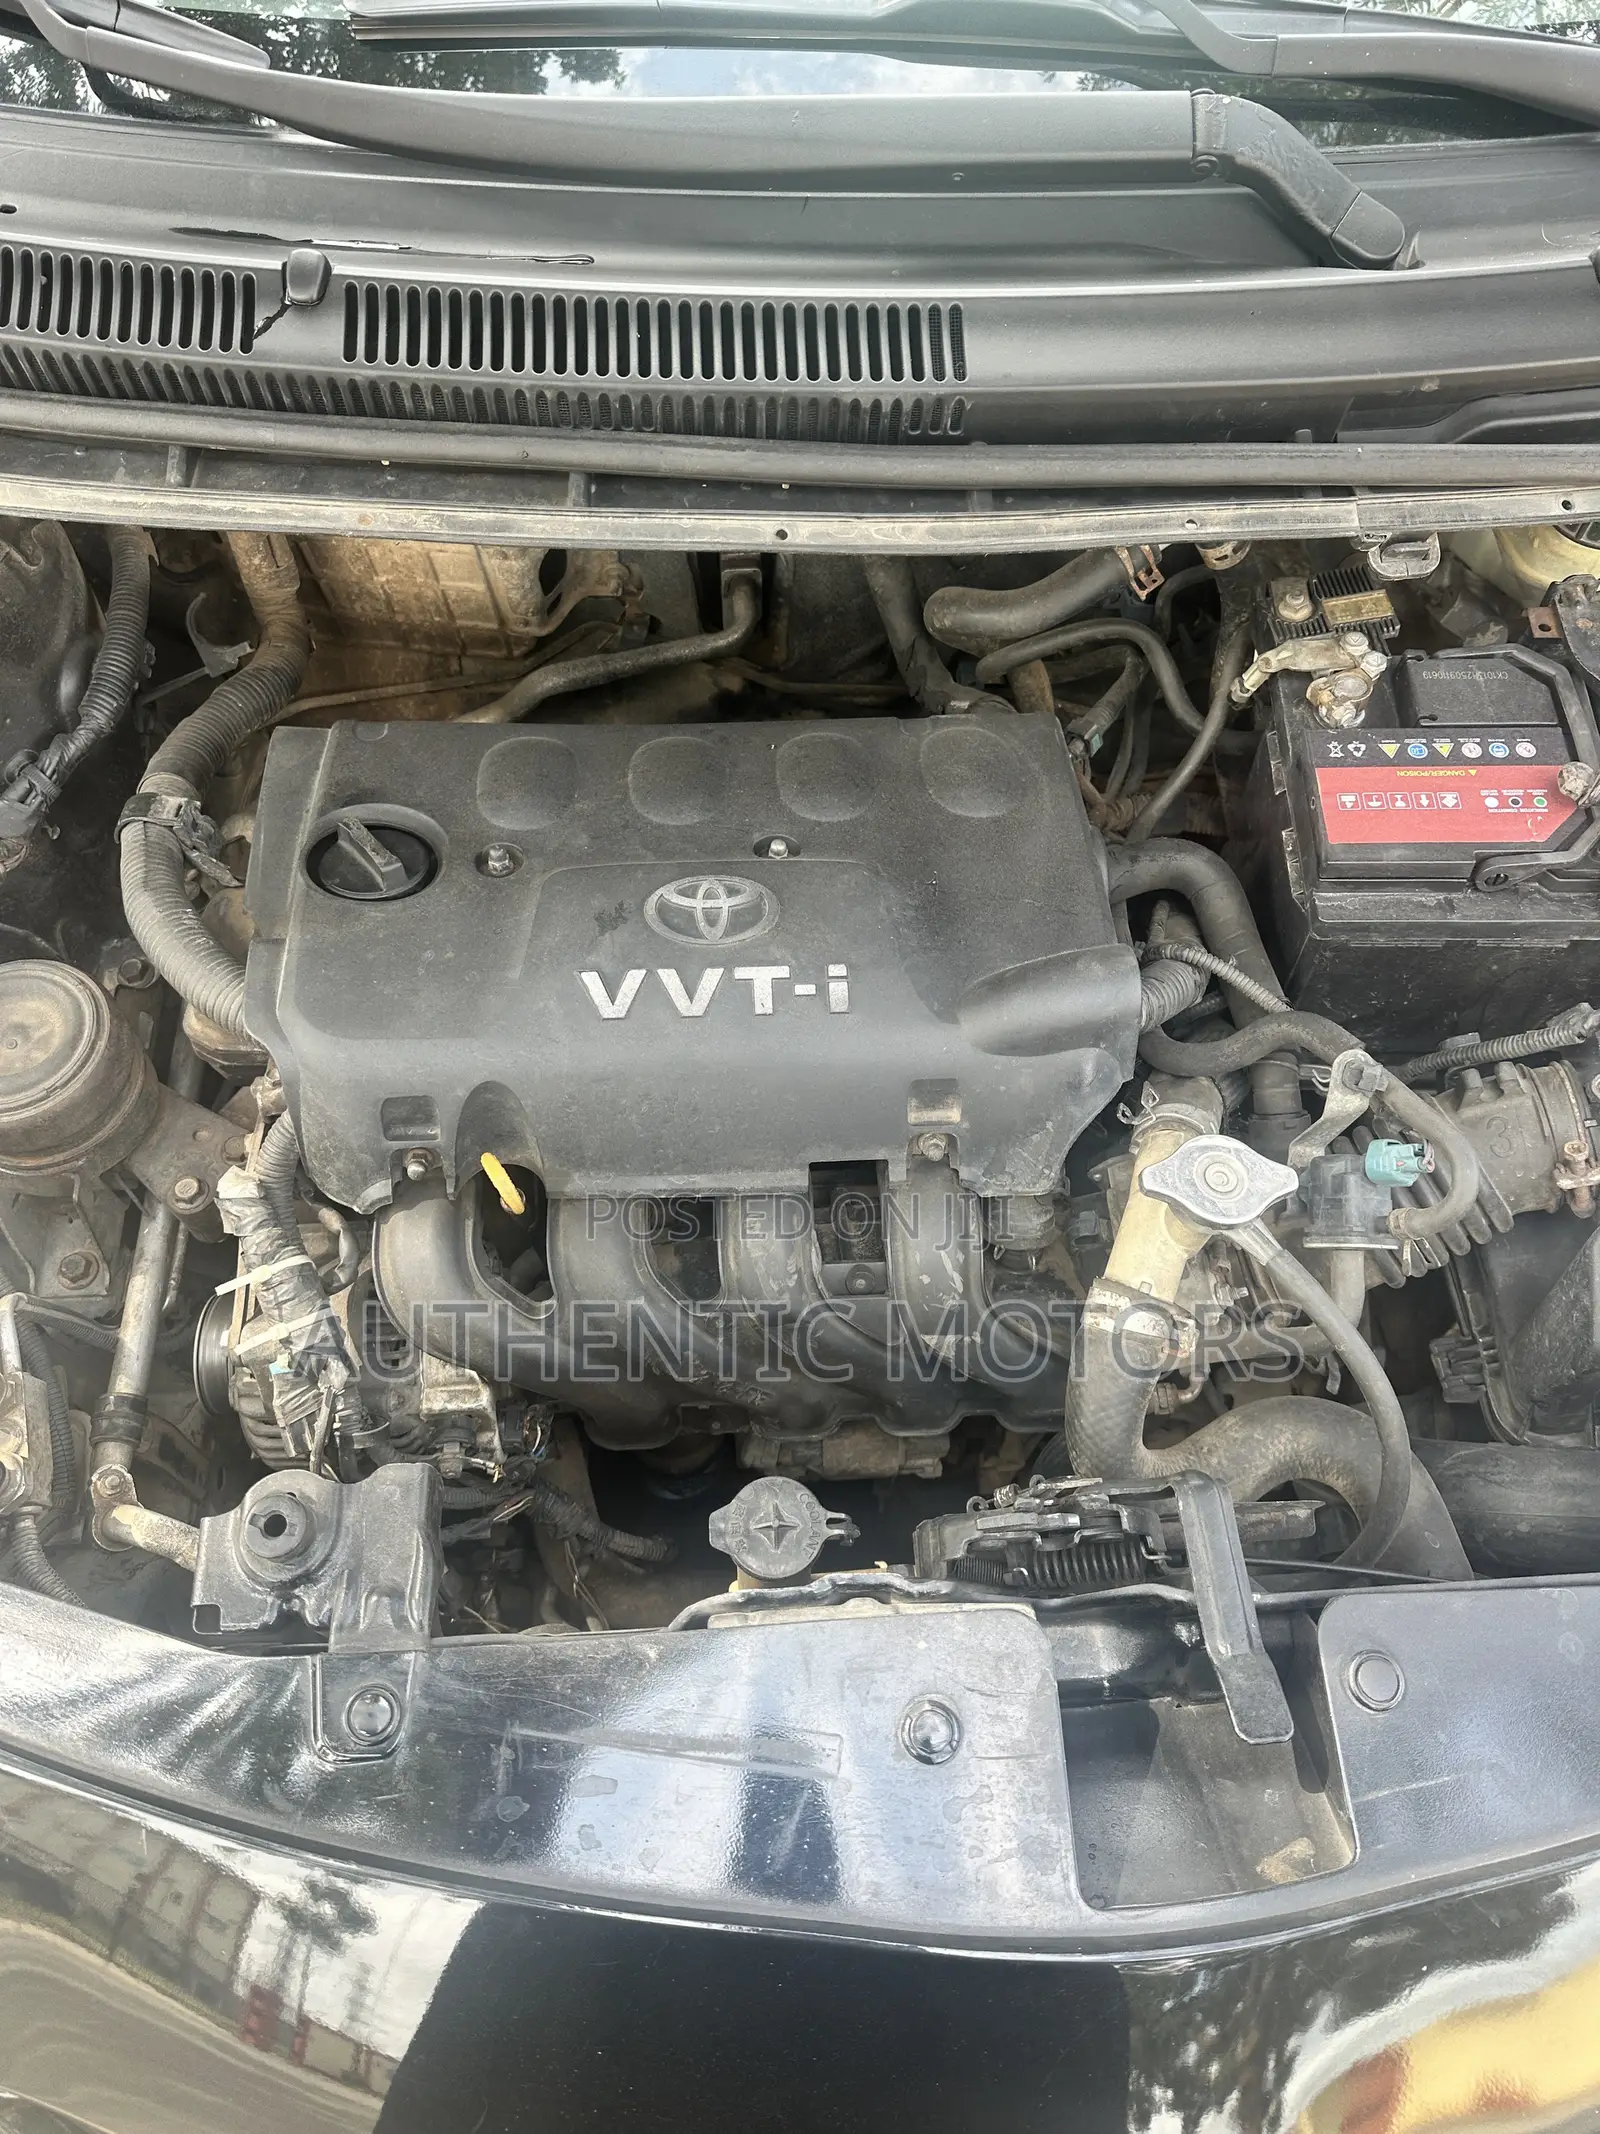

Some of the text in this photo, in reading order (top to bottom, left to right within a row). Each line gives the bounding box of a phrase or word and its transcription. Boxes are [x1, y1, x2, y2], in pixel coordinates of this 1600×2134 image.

[575, 963, 852, 1020] VVT-i
[1486, 1115, 1512, 1159] 3
[799, 1492, 822, 1560] COOLANT
